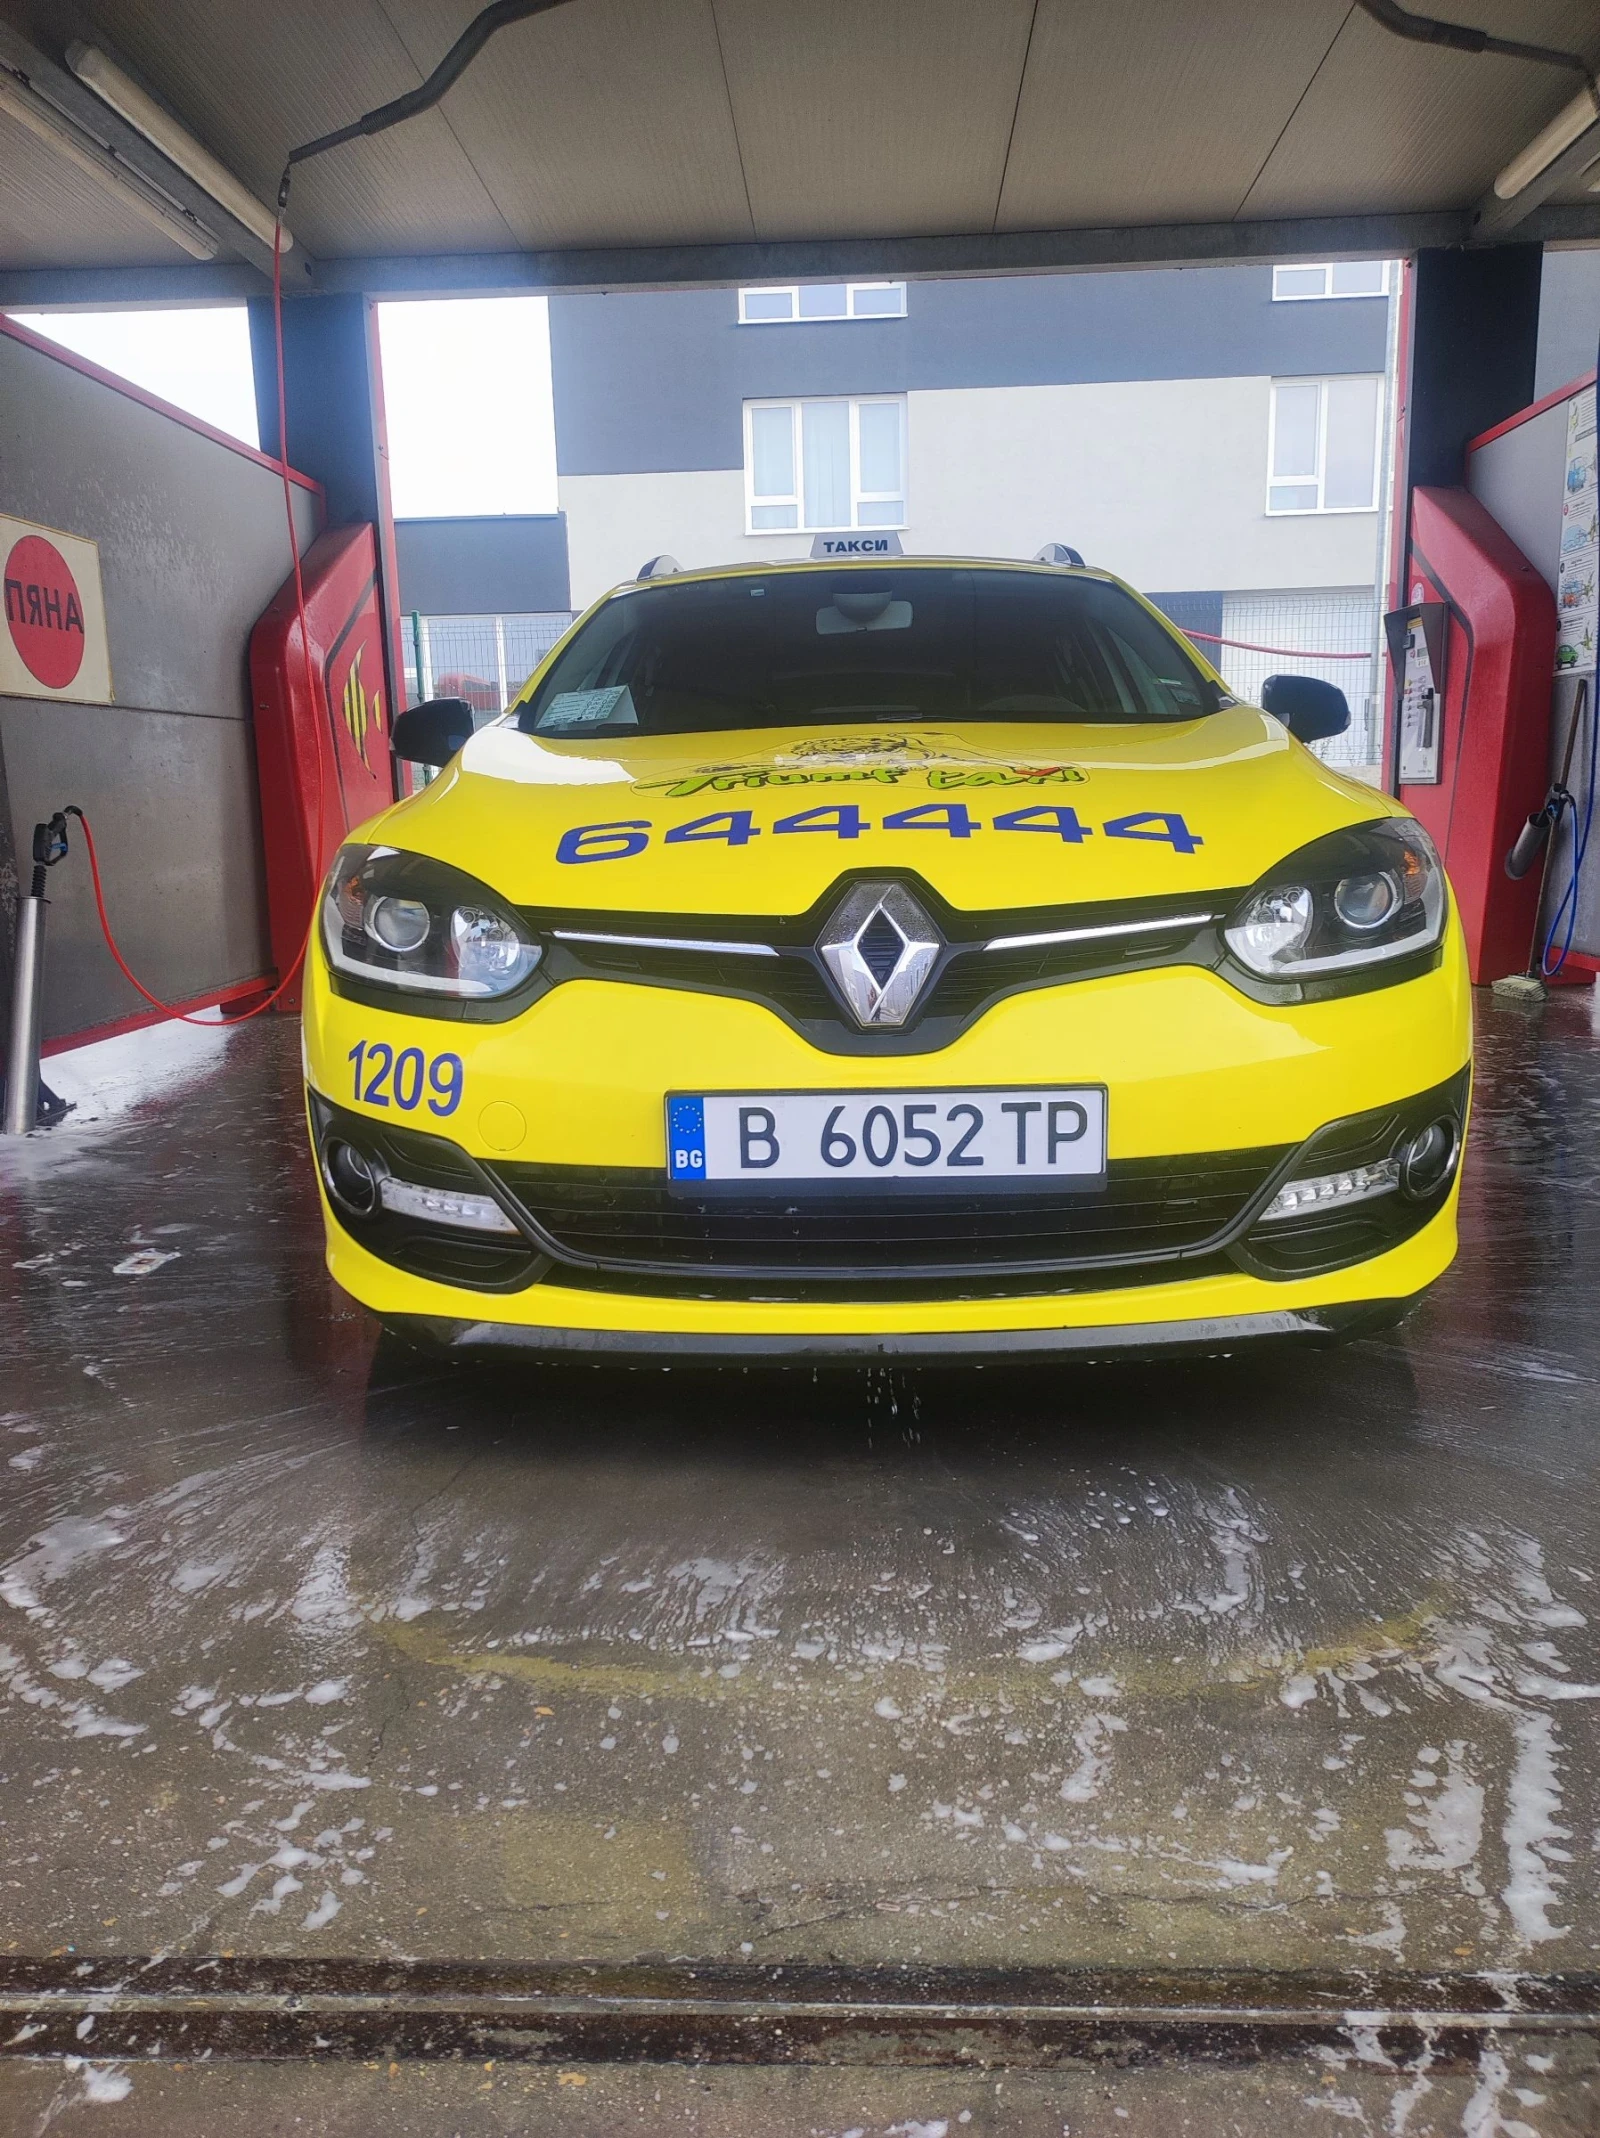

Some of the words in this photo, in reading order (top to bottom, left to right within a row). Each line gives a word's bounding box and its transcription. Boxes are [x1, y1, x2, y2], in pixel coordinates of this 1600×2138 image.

[823, 539, 888, 553] ТАКСИ
[4, 578, 84, 634] ПЯНА
[926, 766, 1085, 790] taxi
[555, 803, 1205, 864] 644444
[347, 1039, 464, 1117] 1209
[675, 1149, 703, 1169] BG
[820, 1103, 984, 1168] 6052
